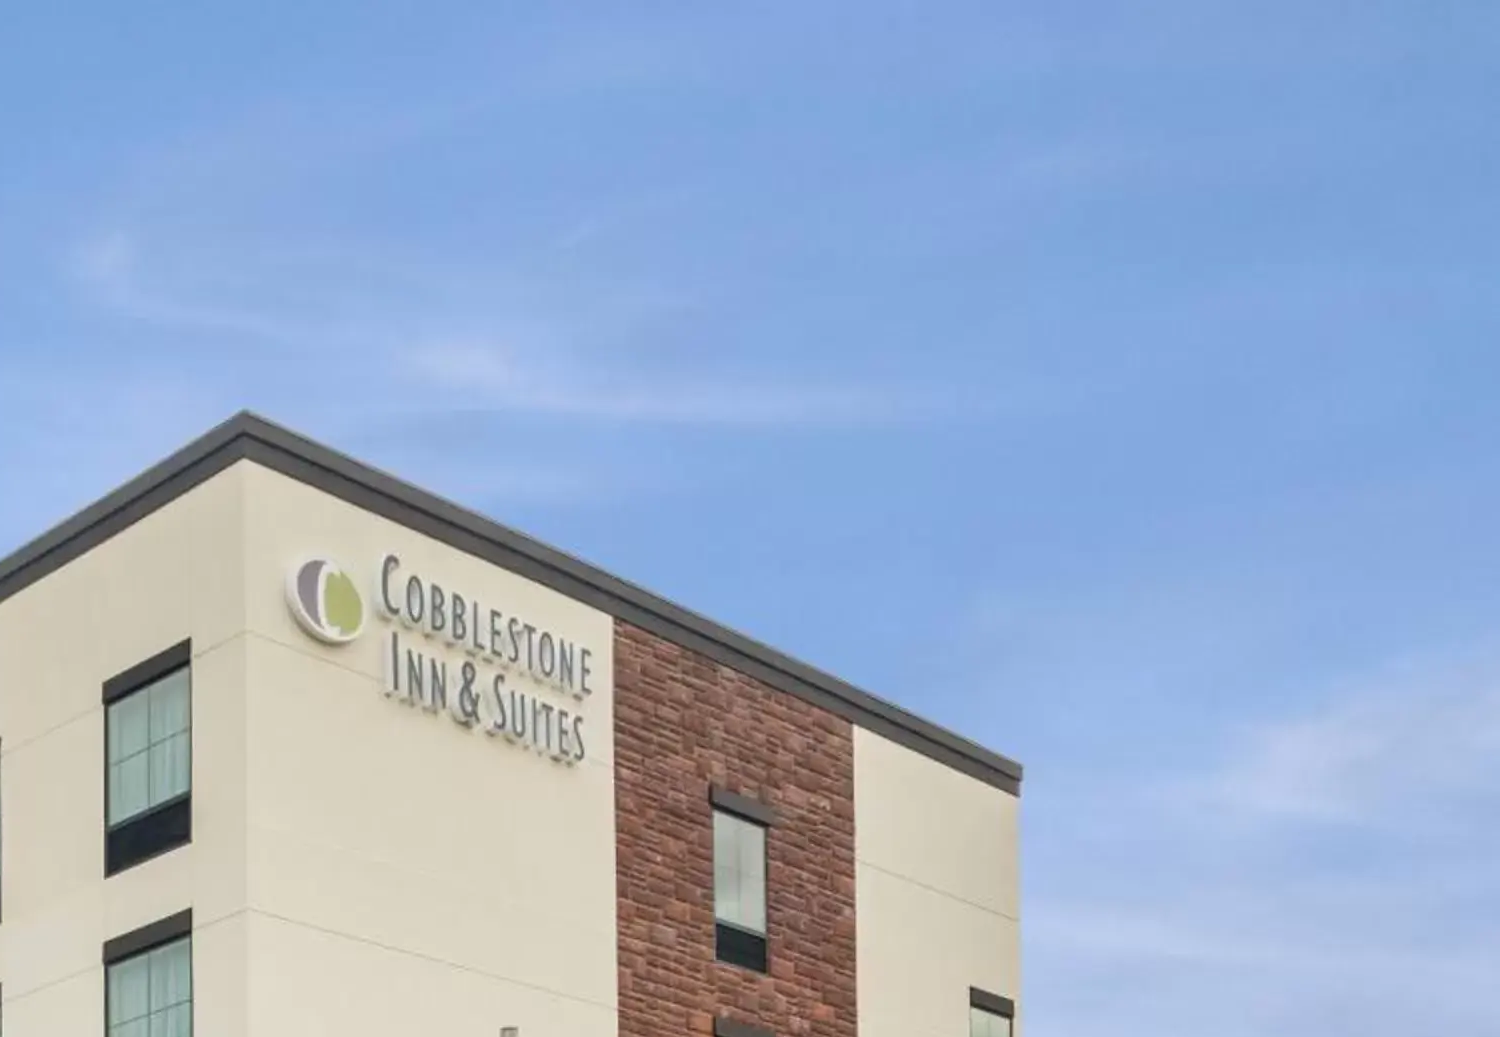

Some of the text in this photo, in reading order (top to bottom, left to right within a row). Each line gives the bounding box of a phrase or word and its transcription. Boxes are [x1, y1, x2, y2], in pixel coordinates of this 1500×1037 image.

[380, 553, 593, 696] COBBLESTONE
[390, 631, 586, 763] INN & SUITES
